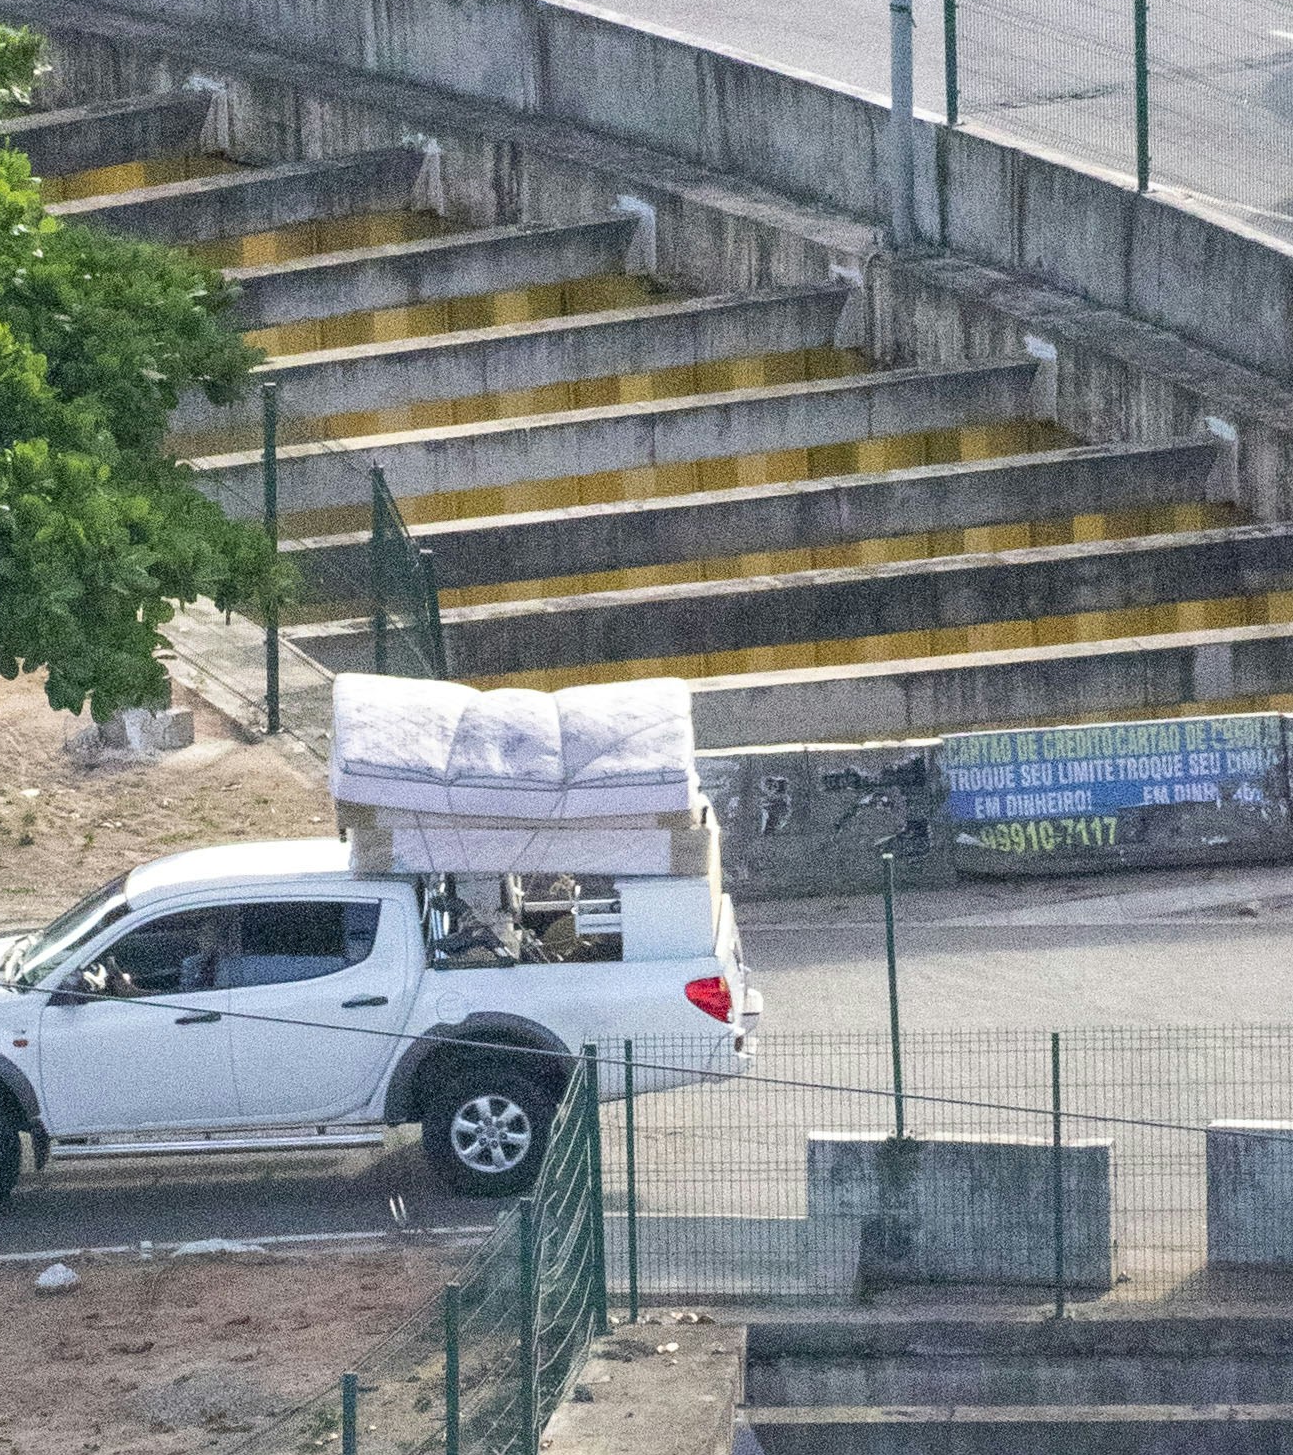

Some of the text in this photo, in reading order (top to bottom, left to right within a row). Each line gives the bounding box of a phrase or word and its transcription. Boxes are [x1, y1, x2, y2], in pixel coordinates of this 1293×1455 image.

[1017, 733, 1039, 762] DE
[1185, 723, 1206, 751] DE
[948, 759, 1114, 792] TROQUE SEU LIMITE
[1119, 754, 1183, 781] TROQUE
[1188, 751, 1221, 776] SEU
[974, 790, 1093, 819] EM DINHEIRO!
[1143, 787, 1170, 805] EM
